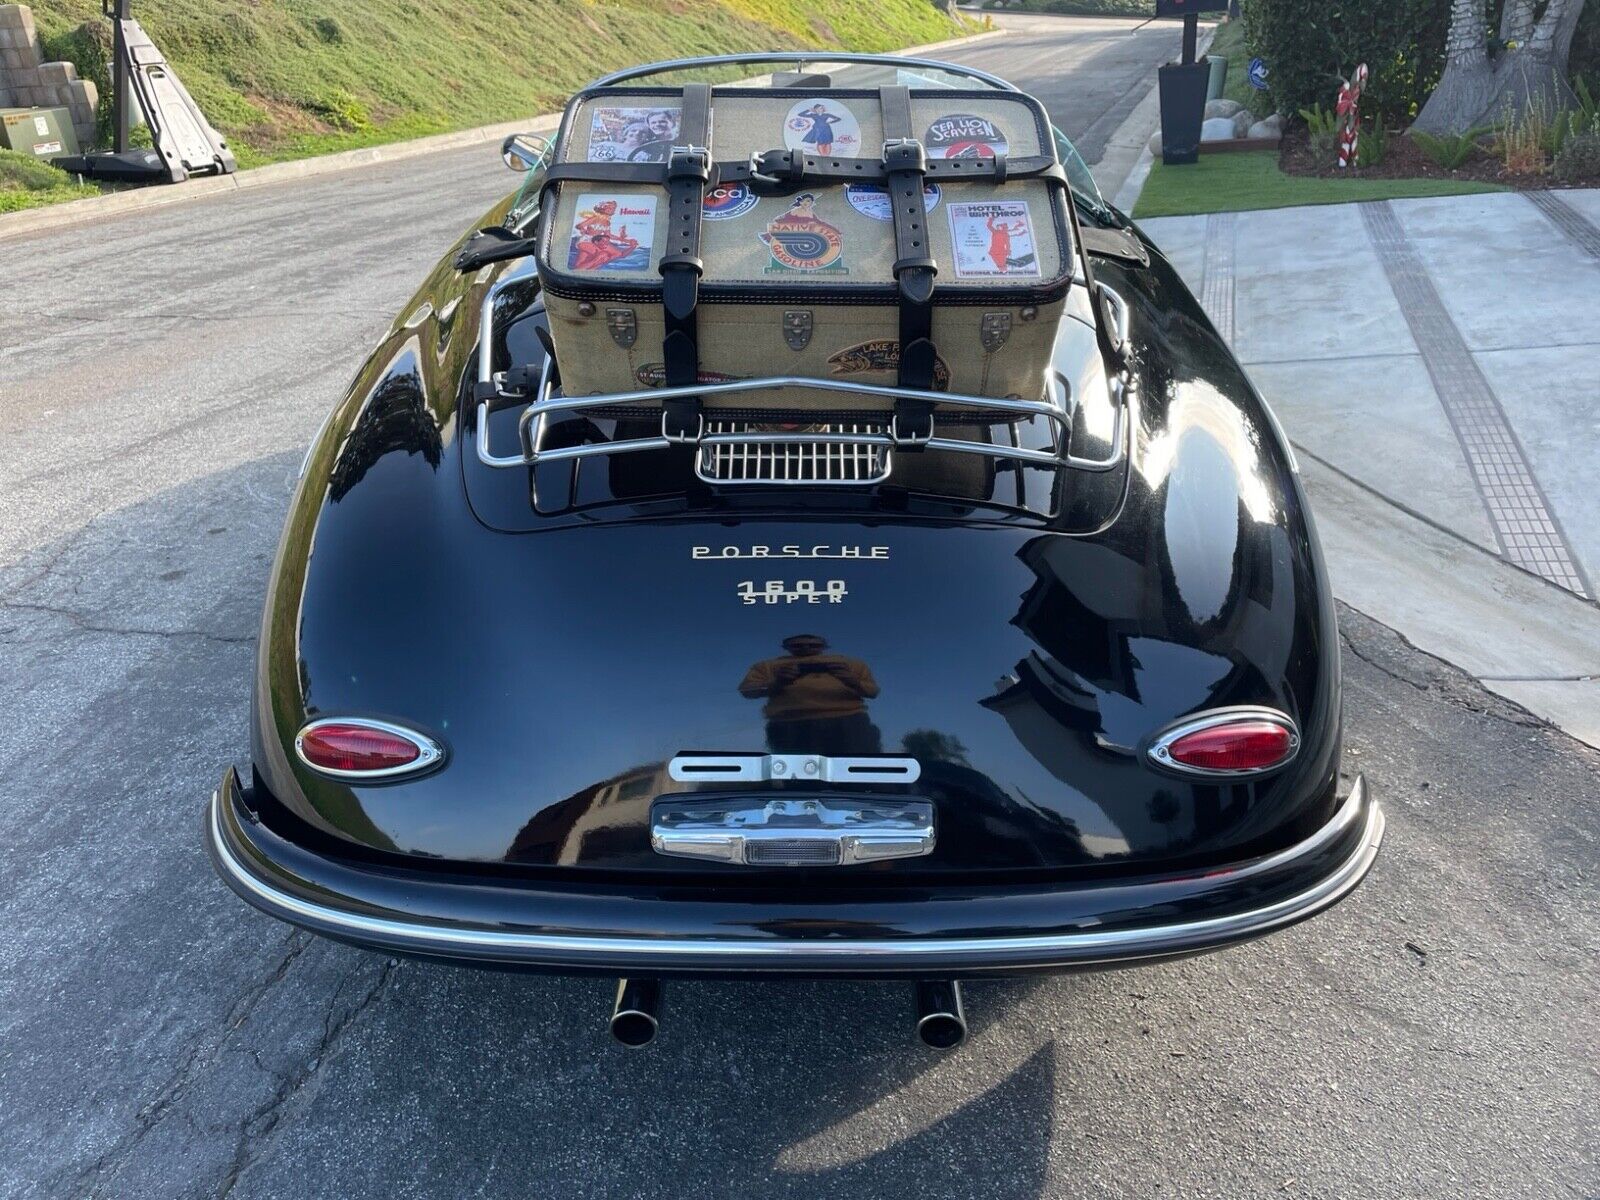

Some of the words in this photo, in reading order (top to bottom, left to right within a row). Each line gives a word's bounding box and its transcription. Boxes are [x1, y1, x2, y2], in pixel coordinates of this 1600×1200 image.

[930, 121, 954, 141] SEA
[959, 119, 996, 137] LION
[943, 127, 985, 138] CAVES
[597, 150, 613, 159] 66
[704, 188, 742, 199] ca
[619, 207, 651, 216] Hawaii
[771, 223, 815, 231] NATIVE
[819, 226, 841, 247] STATE
[772, 244, 824, 268] GASOLINE
[863, 343, 888, 353] LAKE
[692, 545, 889, 559] PORSCHE
[737, 580, 847, 595] 1600
[743, 593, 842, 605] SUPER
